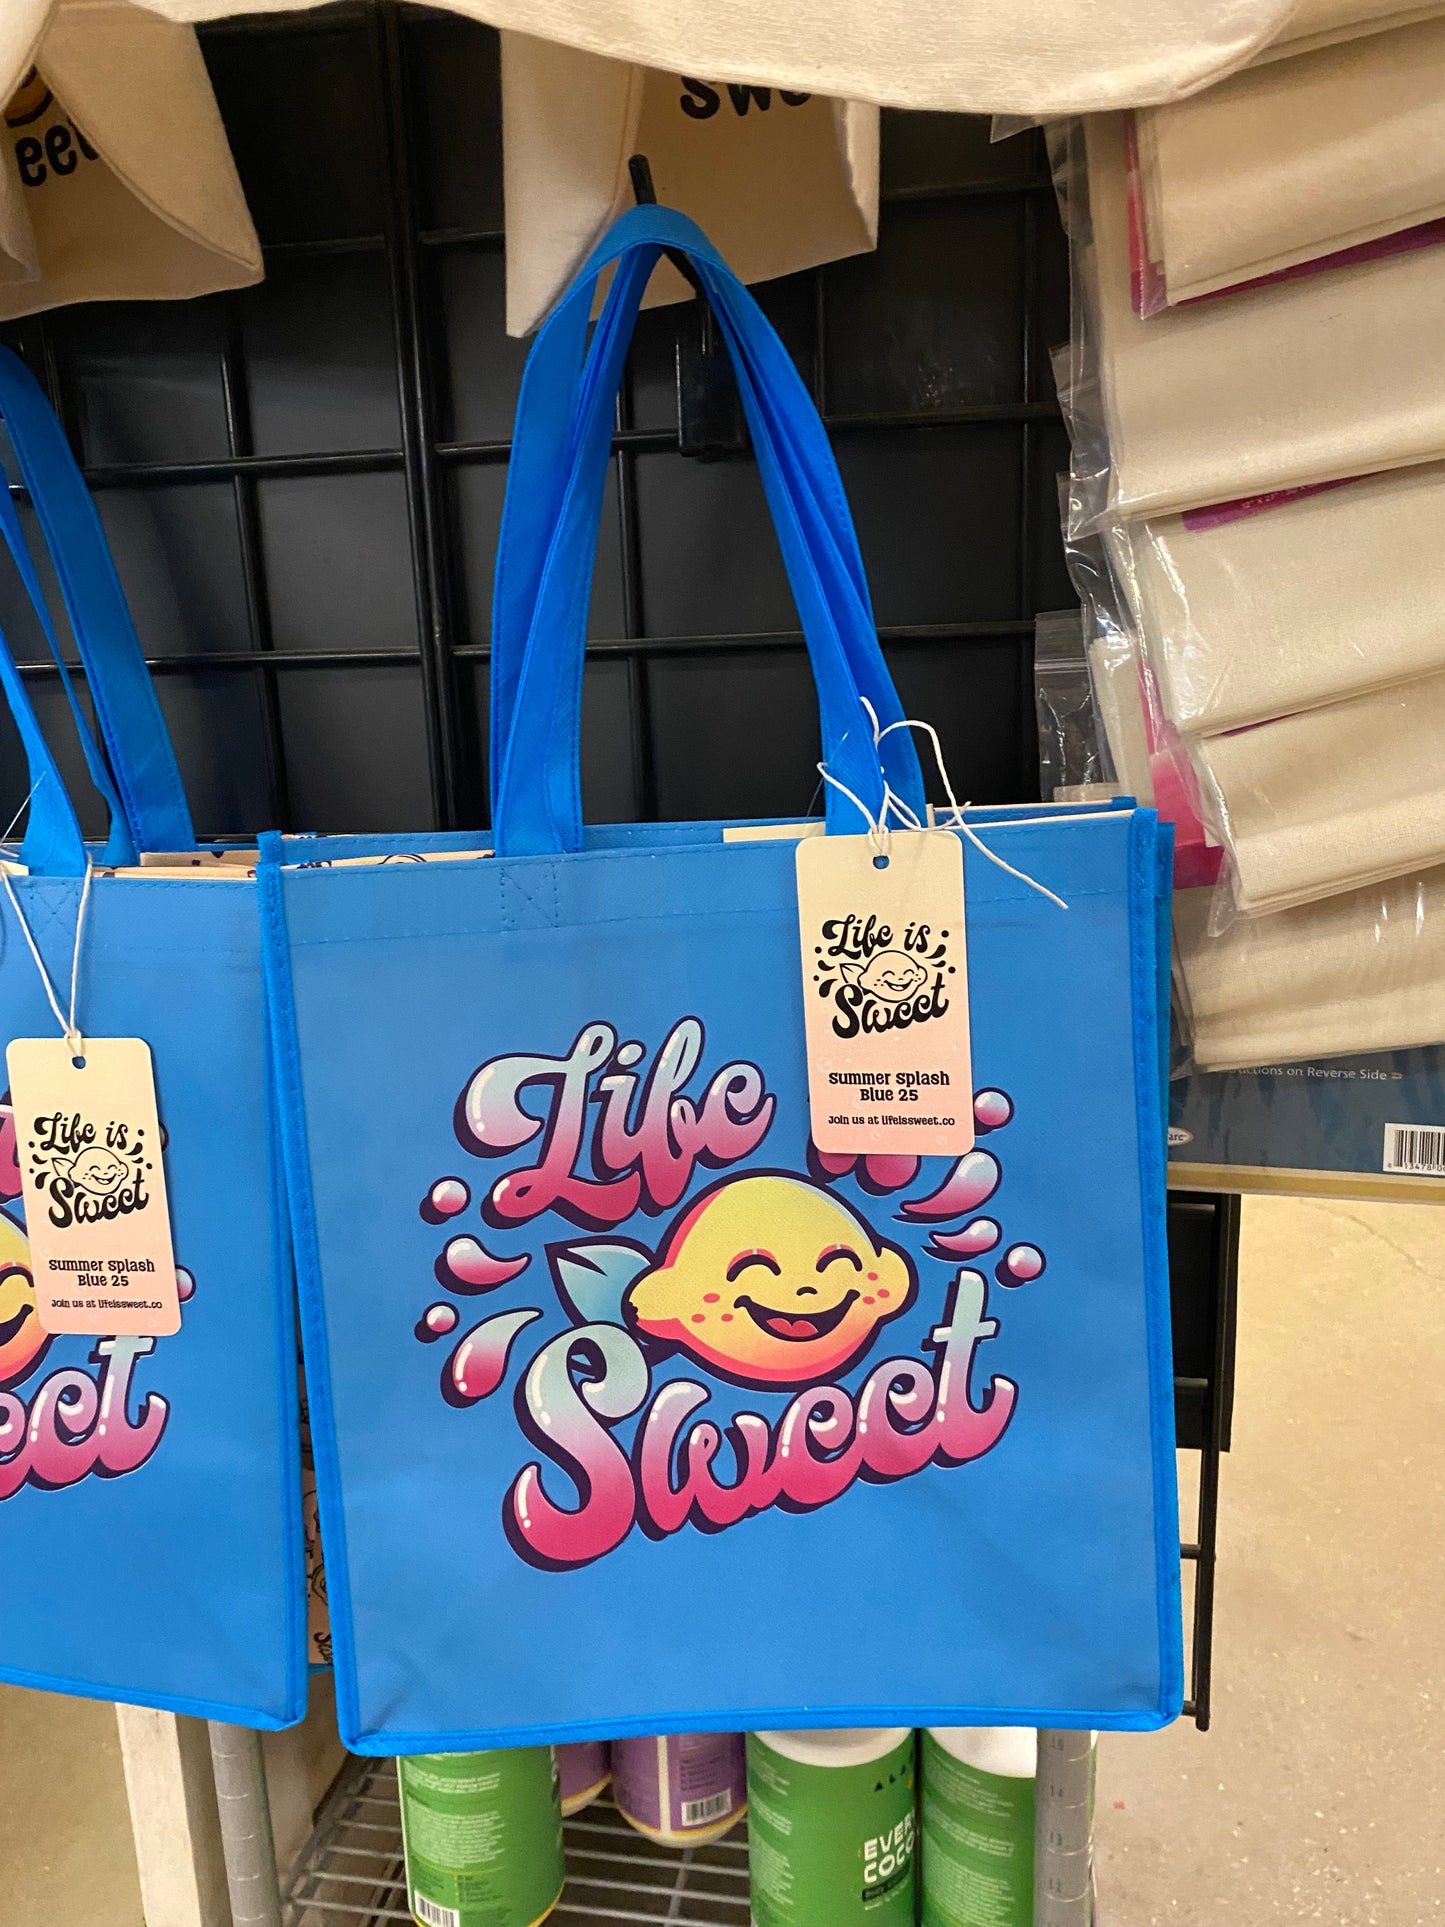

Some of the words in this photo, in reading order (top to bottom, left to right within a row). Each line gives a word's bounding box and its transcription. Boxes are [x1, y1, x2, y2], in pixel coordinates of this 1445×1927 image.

[821, 914, 893, 958] Life
[904, 921, 931, 953] is
[832, 973, 949, 1039] Sweet
[860, 1087, 894, 1101] Blue
[898, 1089, 919, 1101] 25
[1286, 1067, 1303, 1076] on
[1307, 1066, 1356, 1079] Reverse
[1360, 1069, 1387, 1080] Side
[33, 1112, 97, 1155] Life
[105, 1121, 129, 1150] is
[453, 1015, 777, 1228] Life
[828, 1115, 849, 1125] Join
[851, 1116, 865, 1125] us
[867, 1116, 879, 1125] at
[882, 1115, 955, 1126] lifeissweet.co
[48, 1168, 150, 1228] Sweet
[77, 1273, 107, 1287] Blue
[111, 1275, 129, 1287] 25
[51, 1299, 70, 1308] Join
[72, 1300, 84, 1308] us
[85, 1299, 97, 1308] at
[502, 1267, 1019, 1573] Sweet
[864, 1807, 916, 1861] EVER
